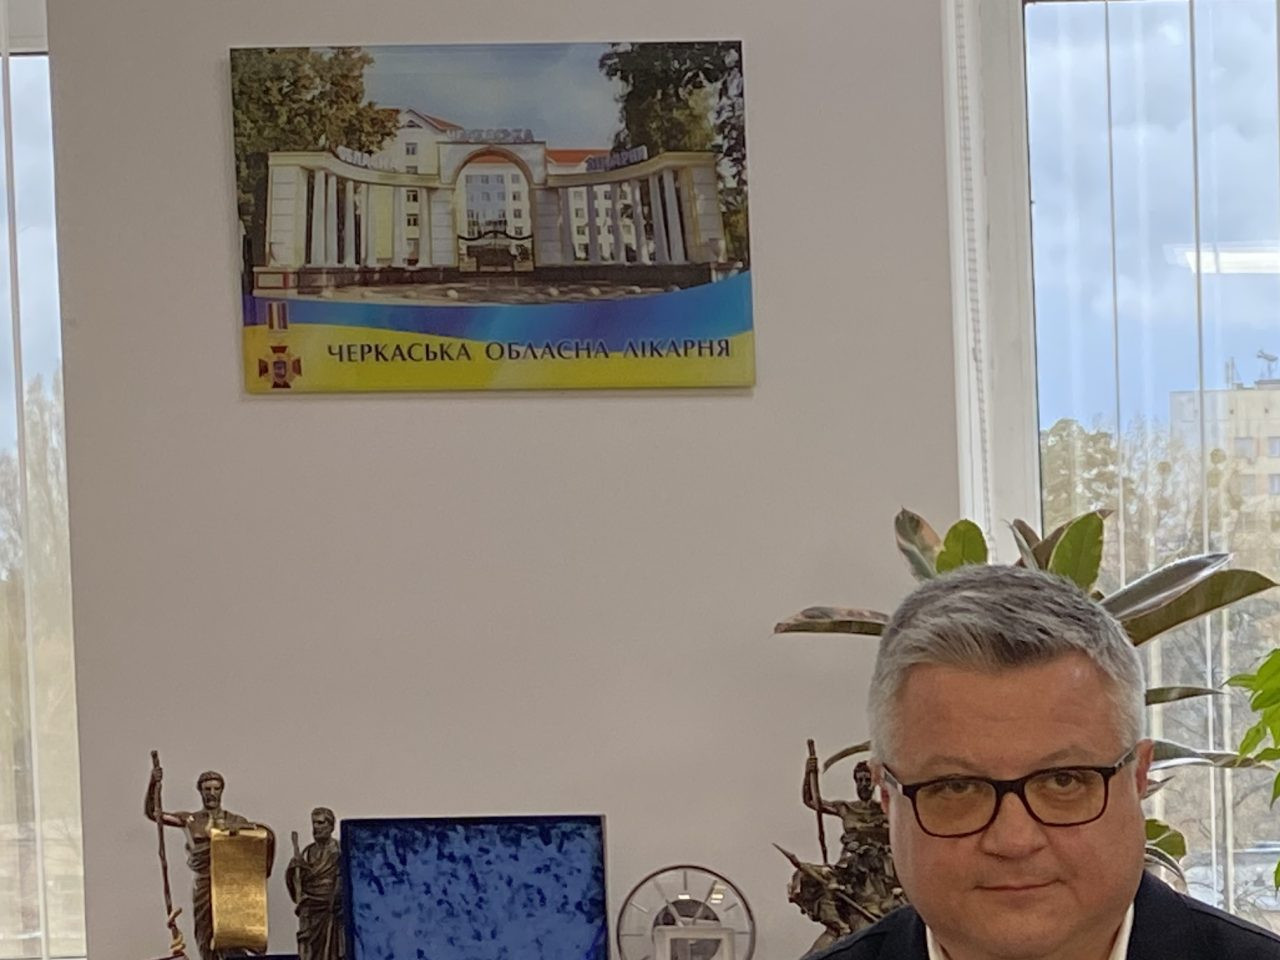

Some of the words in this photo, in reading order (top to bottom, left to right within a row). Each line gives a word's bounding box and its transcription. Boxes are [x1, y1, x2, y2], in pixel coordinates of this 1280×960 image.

[327, 342, 473, 363] ЧЕРКАСЬКА
[485, 339, 610, 360] ОБЛАСНА
[623, 338, 730, 358] ЛІКАРНЯ
